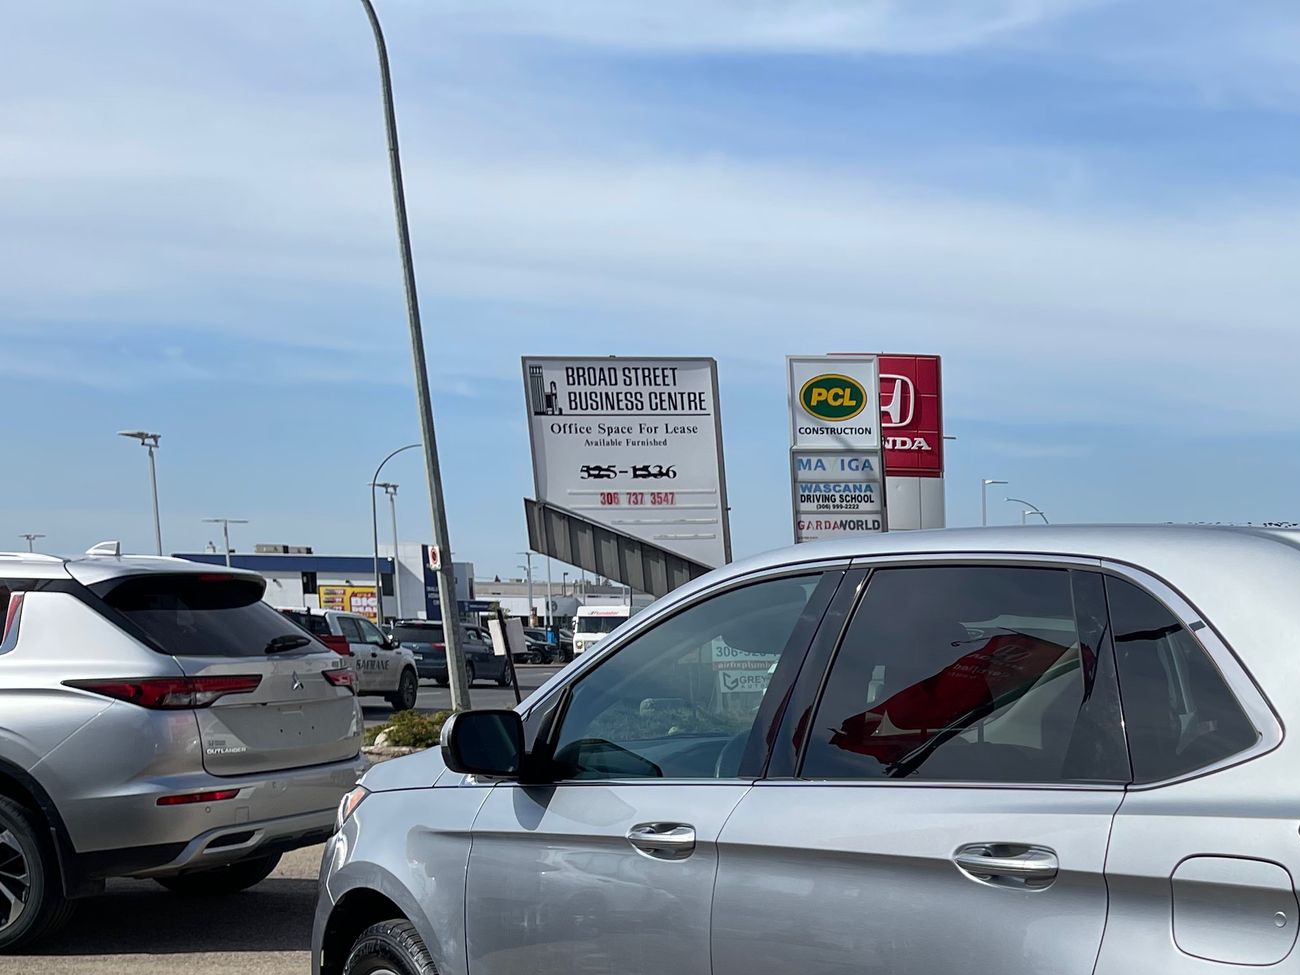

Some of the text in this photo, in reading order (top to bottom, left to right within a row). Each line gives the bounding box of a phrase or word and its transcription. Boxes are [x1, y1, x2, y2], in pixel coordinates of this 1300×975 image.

[565, 366, 678, 387] BROAD STREET
[568, 391, 707, 411] BUSINESS CENTRE
[810, 387, 857, 407] PCL
[550, 422, 699, 436] Office Space For Lease
[798, 426, 873, 436] CONSTRUCTION
[584, 438, 668, 447] Available Furnished
[882, 436, 932, 451] NDA
[799, 483, 874, 494] WASCANA
[599, 492, 676, 506] 306 737 3547
[800, 494, 875, 504] DRIVING SCHOOL
